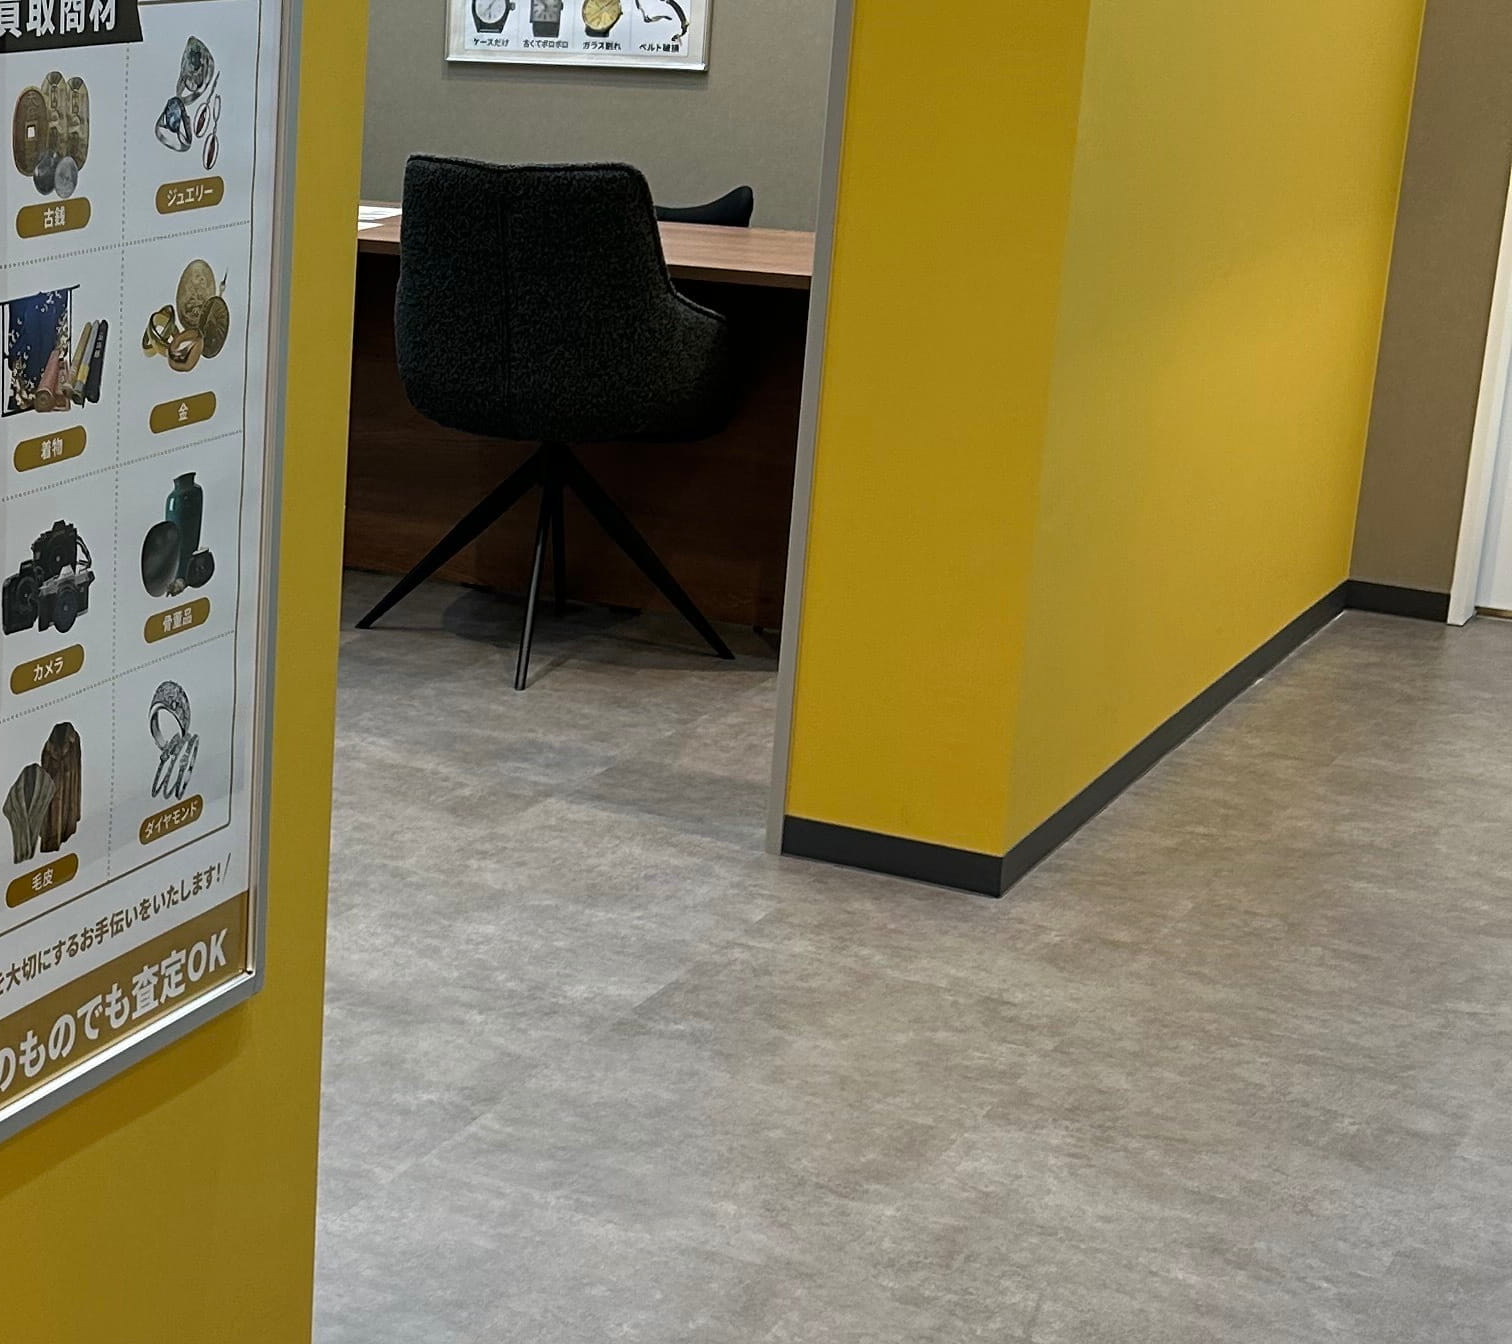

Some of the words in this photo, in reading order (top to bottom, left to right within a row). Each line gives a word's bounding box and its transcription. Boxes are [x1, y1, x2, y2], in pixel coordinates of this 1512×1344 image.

[167, 184, 214, 207] ジュエリー
[177, 402, 190, 422] 金
[39, 437, 64, 461] 着物
[32, 656, 65, 682] カメラ
[144, 800, 198, 840] ダイヤモンド
[31, 866, 56, 891] 毛皮
